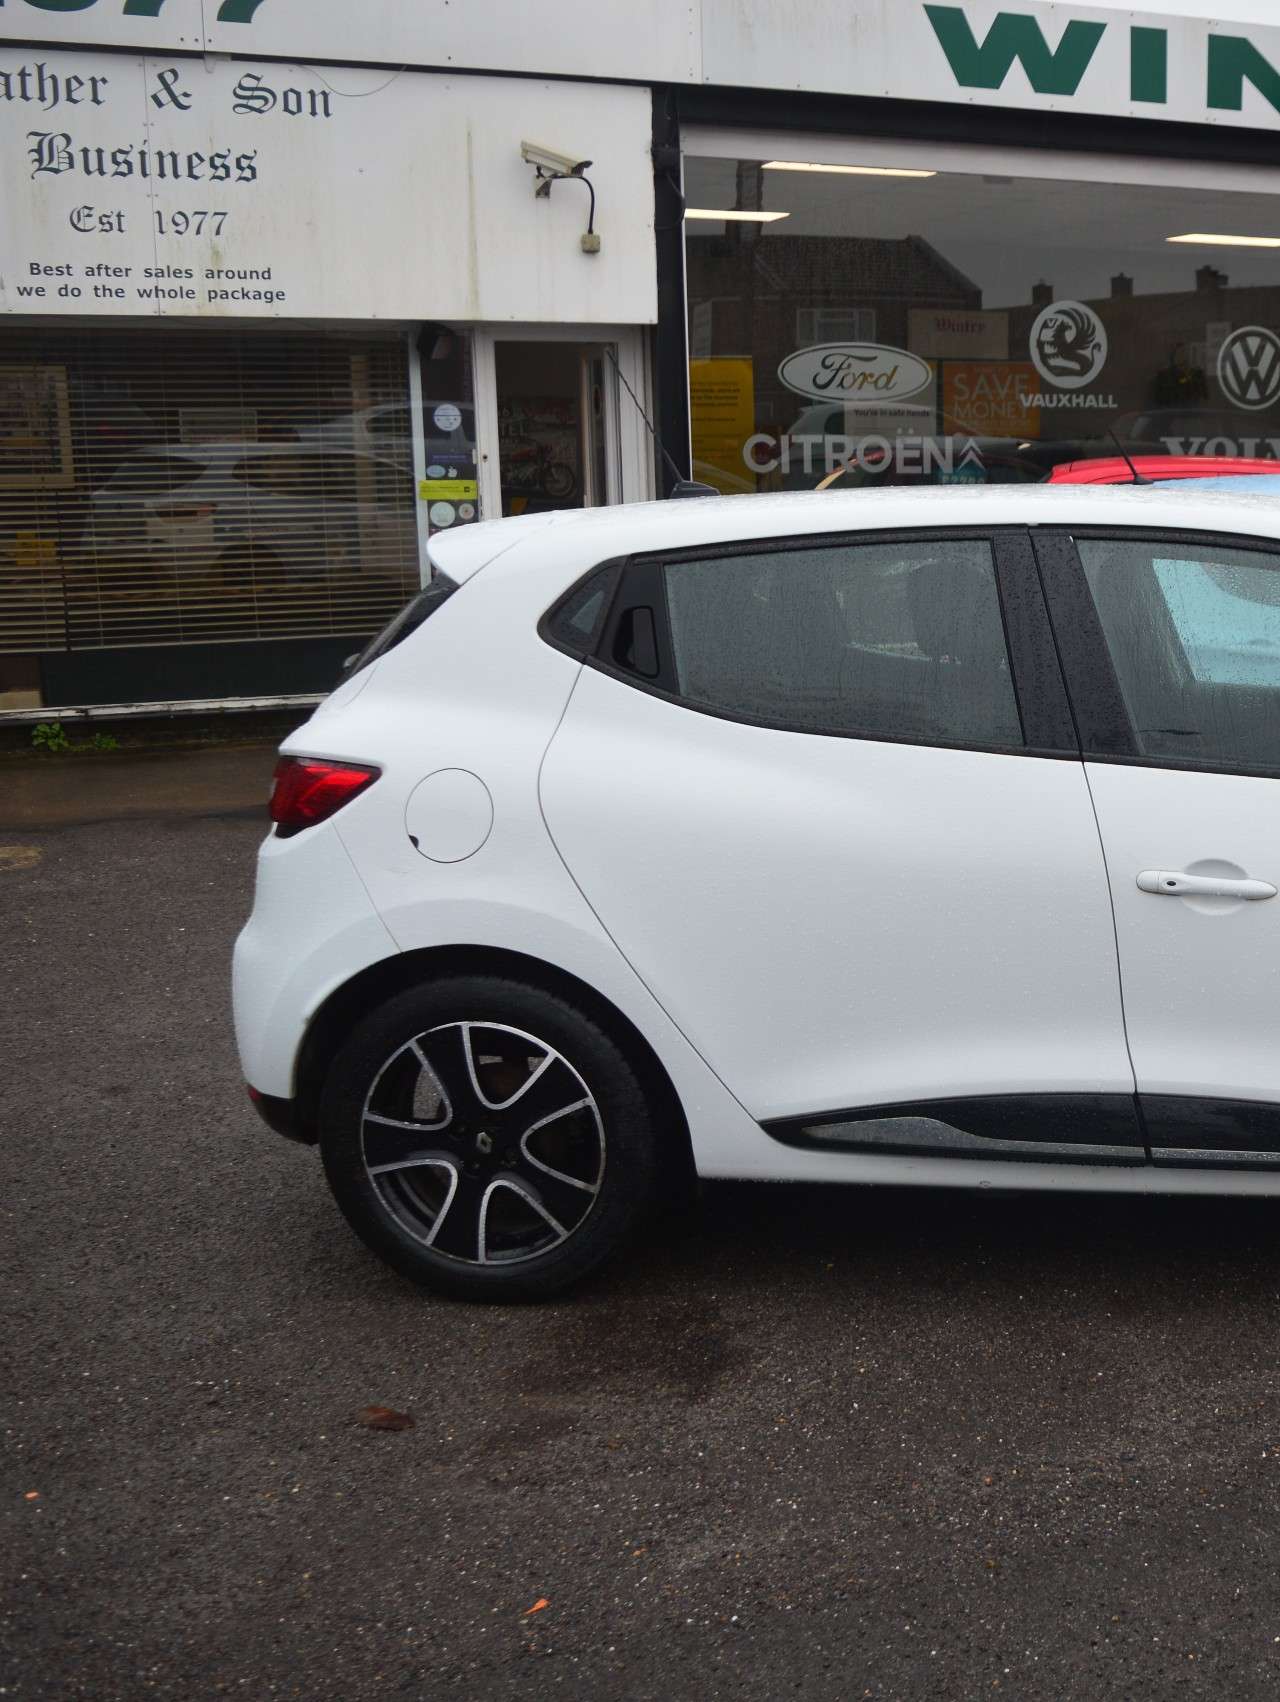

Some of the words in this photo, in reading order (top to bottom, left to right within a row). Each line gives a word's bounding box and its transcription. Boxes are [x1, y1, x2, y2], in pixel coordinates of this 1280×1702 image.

[0, 62, 108, 110] ather
[150, 68, 192, 111] &
[232, 72, 334, 118] Son
[26, 130, 258, 182] Business
[69, 205, 126, 234] Est
[154, 210, 228, 236] 1977
[29, 262, 73, 278] Best
[85, 263, 132, 279] after
[144, 265, 193, 280] sales
[205, 266, 272, 281] around
[17, 285, 46, 298] we
[58, 284, 82, 299] do
[94, 284, 125, 299] the
[137, 284, 196, 300] whole
[208, 287, 286, 304] package
[812, 352, 898, 391] Ford
[953, 373, 1030, 401] SAVE
[1019, 393, 1118, 409] VAUXHALL
[742, 427, 953, 474] CITROËN
